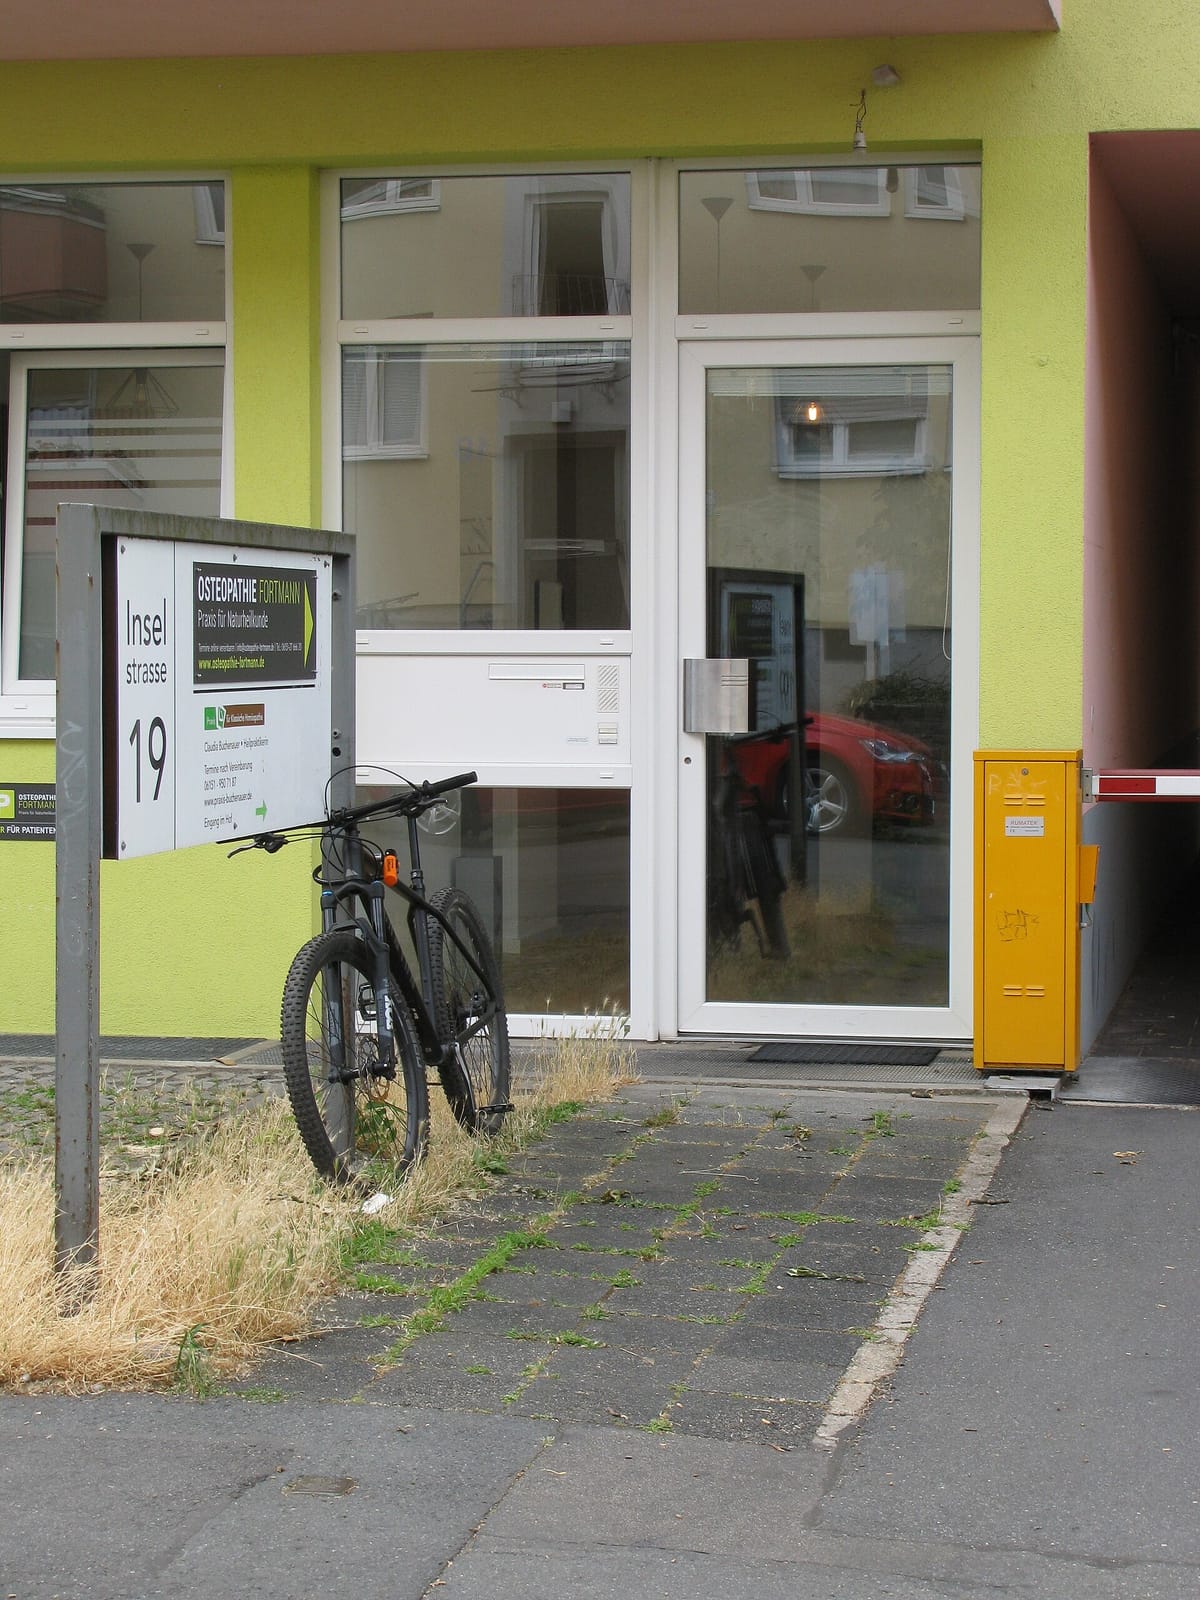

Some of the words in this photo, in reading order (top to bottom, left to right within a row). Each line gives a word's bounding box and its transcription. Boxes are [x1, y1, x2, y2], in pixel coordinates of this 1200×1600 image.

[198, 576, 257, 603] OSTEOPATHIE
[259, 579, 300, 604] FORTMANN
[127, 598, 166, 646] Insel
[198, 609, 217, 628] Praxis
[218, 609, 226, 628] für
[228, 610, 268, 628] Naturheilkunde
[126, 658, 167, 684] strasse
[198, 656, 265, 671] www.osteopathie-fortmann.de
[204, 741, 218, 752] Claudia
[219, 740, 240, 751] Buchenauer
[129, 716, 167, 803] 19
[204, 764, 219, 774] Termine
[220, 761, 228, 773] nach
[229, 760, 252, 772] Vereinbarung
[18, 801, 56, 809] FORTMAN
[7, 825, 20, 833] FÜR
[204, 817, 219, 829] Eingang
